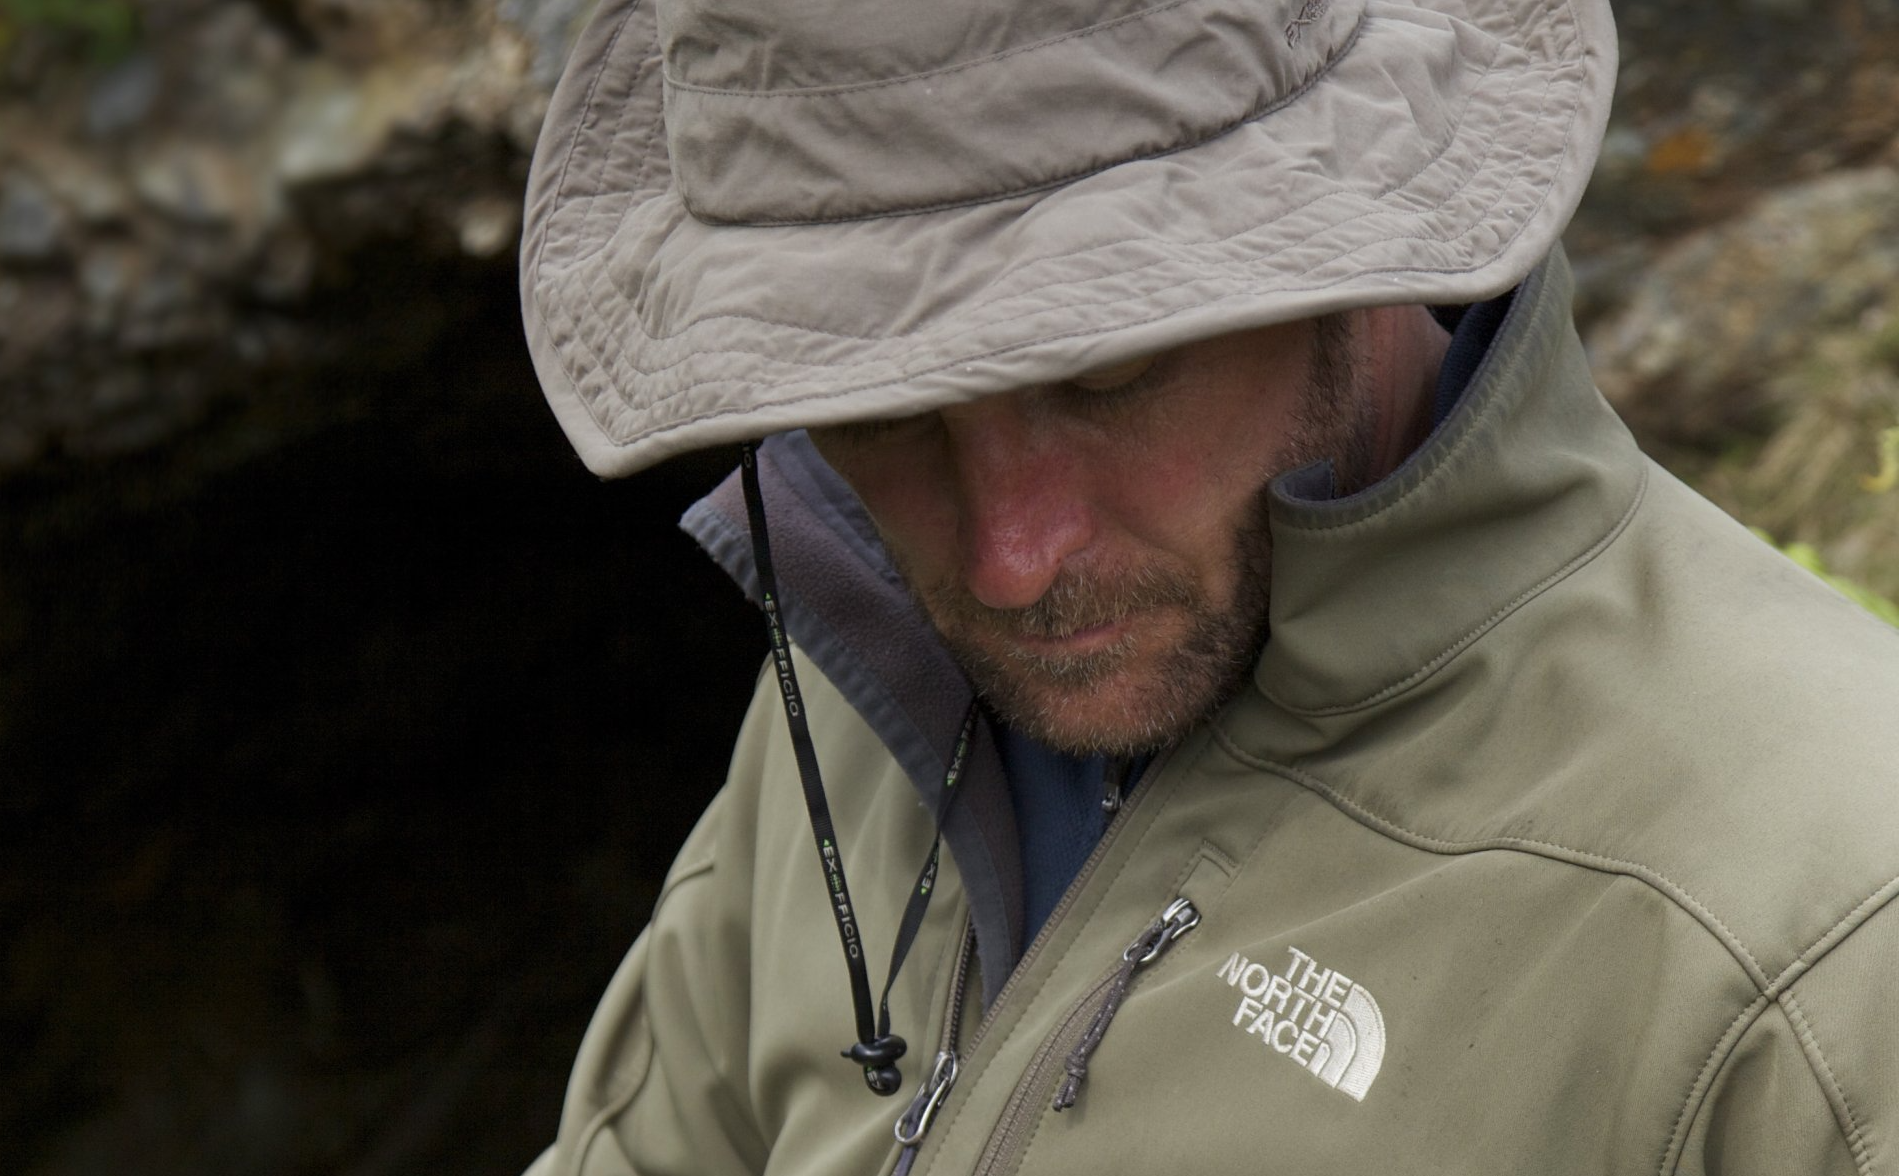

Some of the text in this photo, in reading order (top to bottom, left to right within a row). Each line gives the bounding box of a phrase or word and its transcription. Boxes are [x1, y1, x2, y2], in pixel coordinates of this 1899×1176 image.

[1216, 952, 1338, 1039] NORTH
[1285, 945, 1353, 1009] THE
[1232, 996, 1321, 1068] FACE
